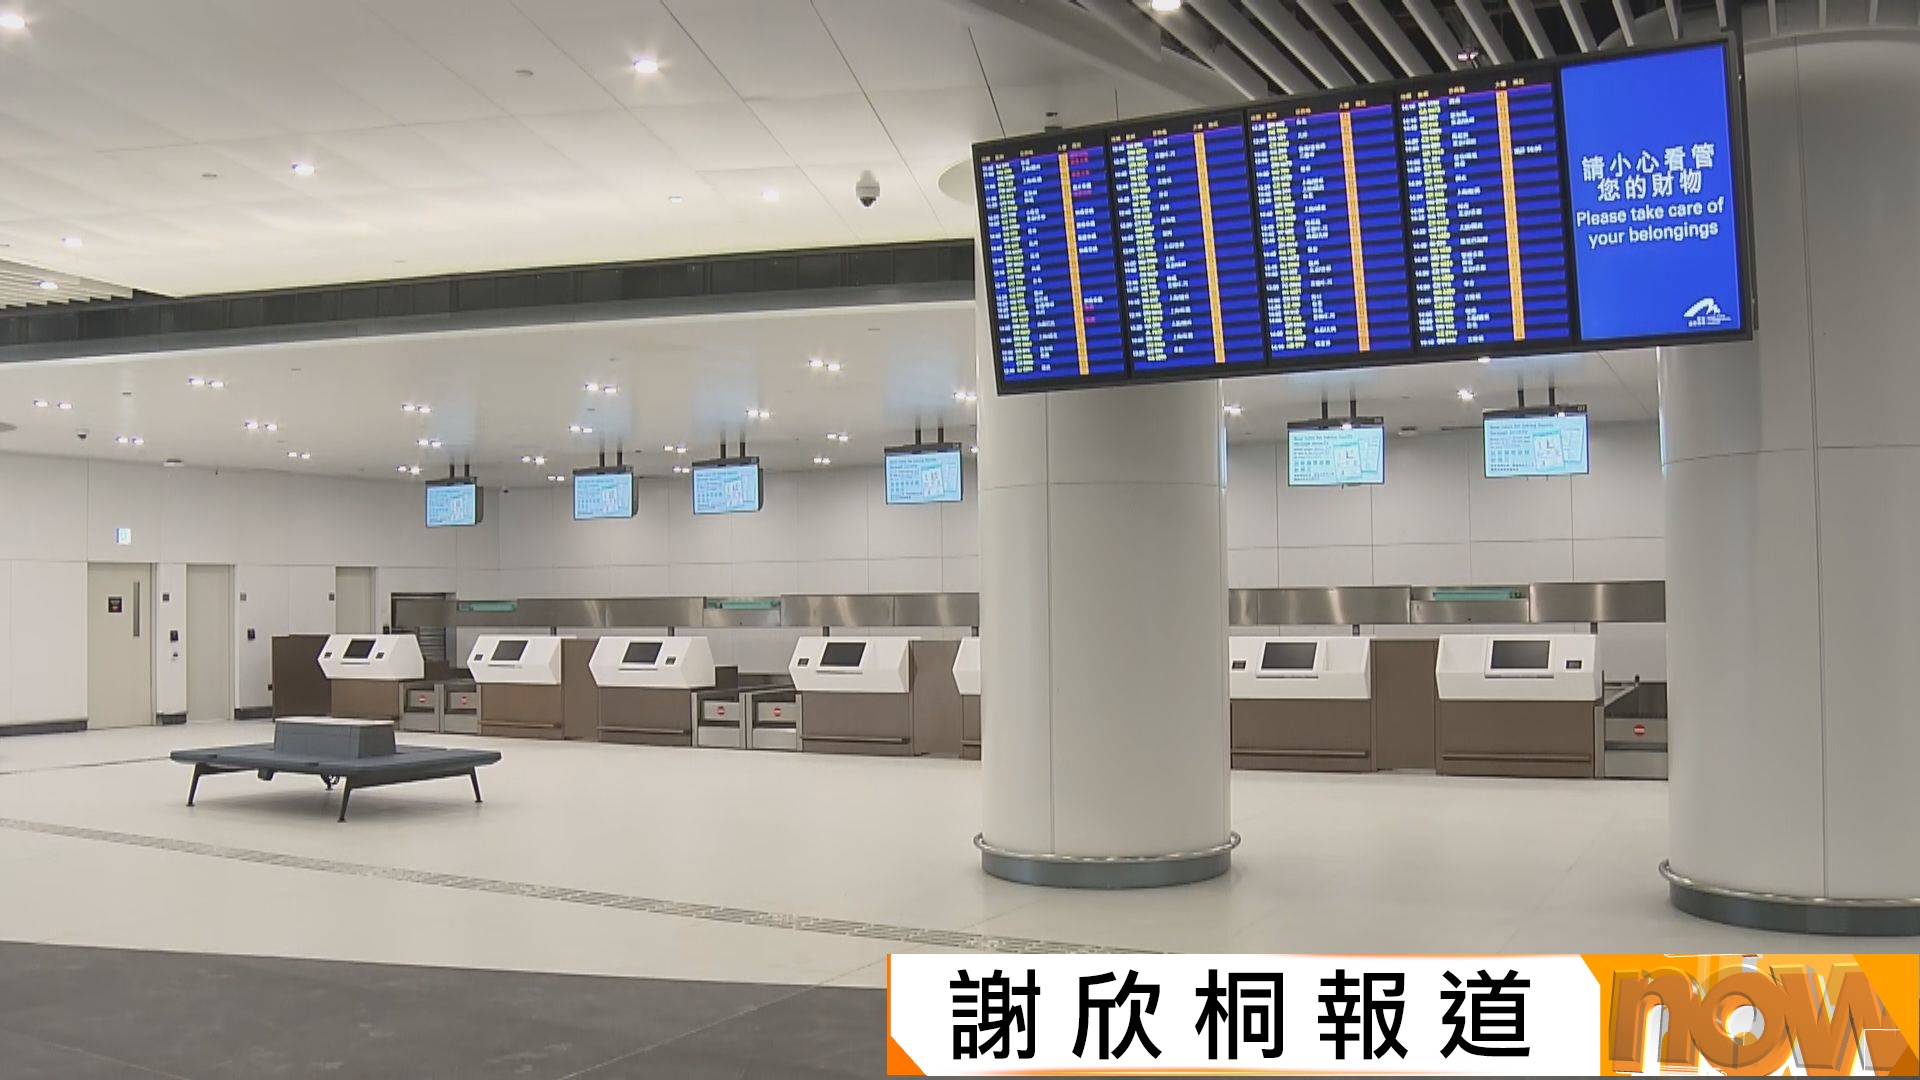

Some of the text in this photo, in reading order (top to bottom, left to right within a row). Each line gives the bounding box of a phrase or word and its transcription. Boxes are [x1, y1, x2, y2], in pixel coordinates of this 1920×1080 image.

[1581, 142, 1715, 181] 請小心看管
[1597, 167, 1702, 202] 您的財物
[1576, 196, 1725, 228] Please take care of
[1588, 221, 1719, 250] your belongings
